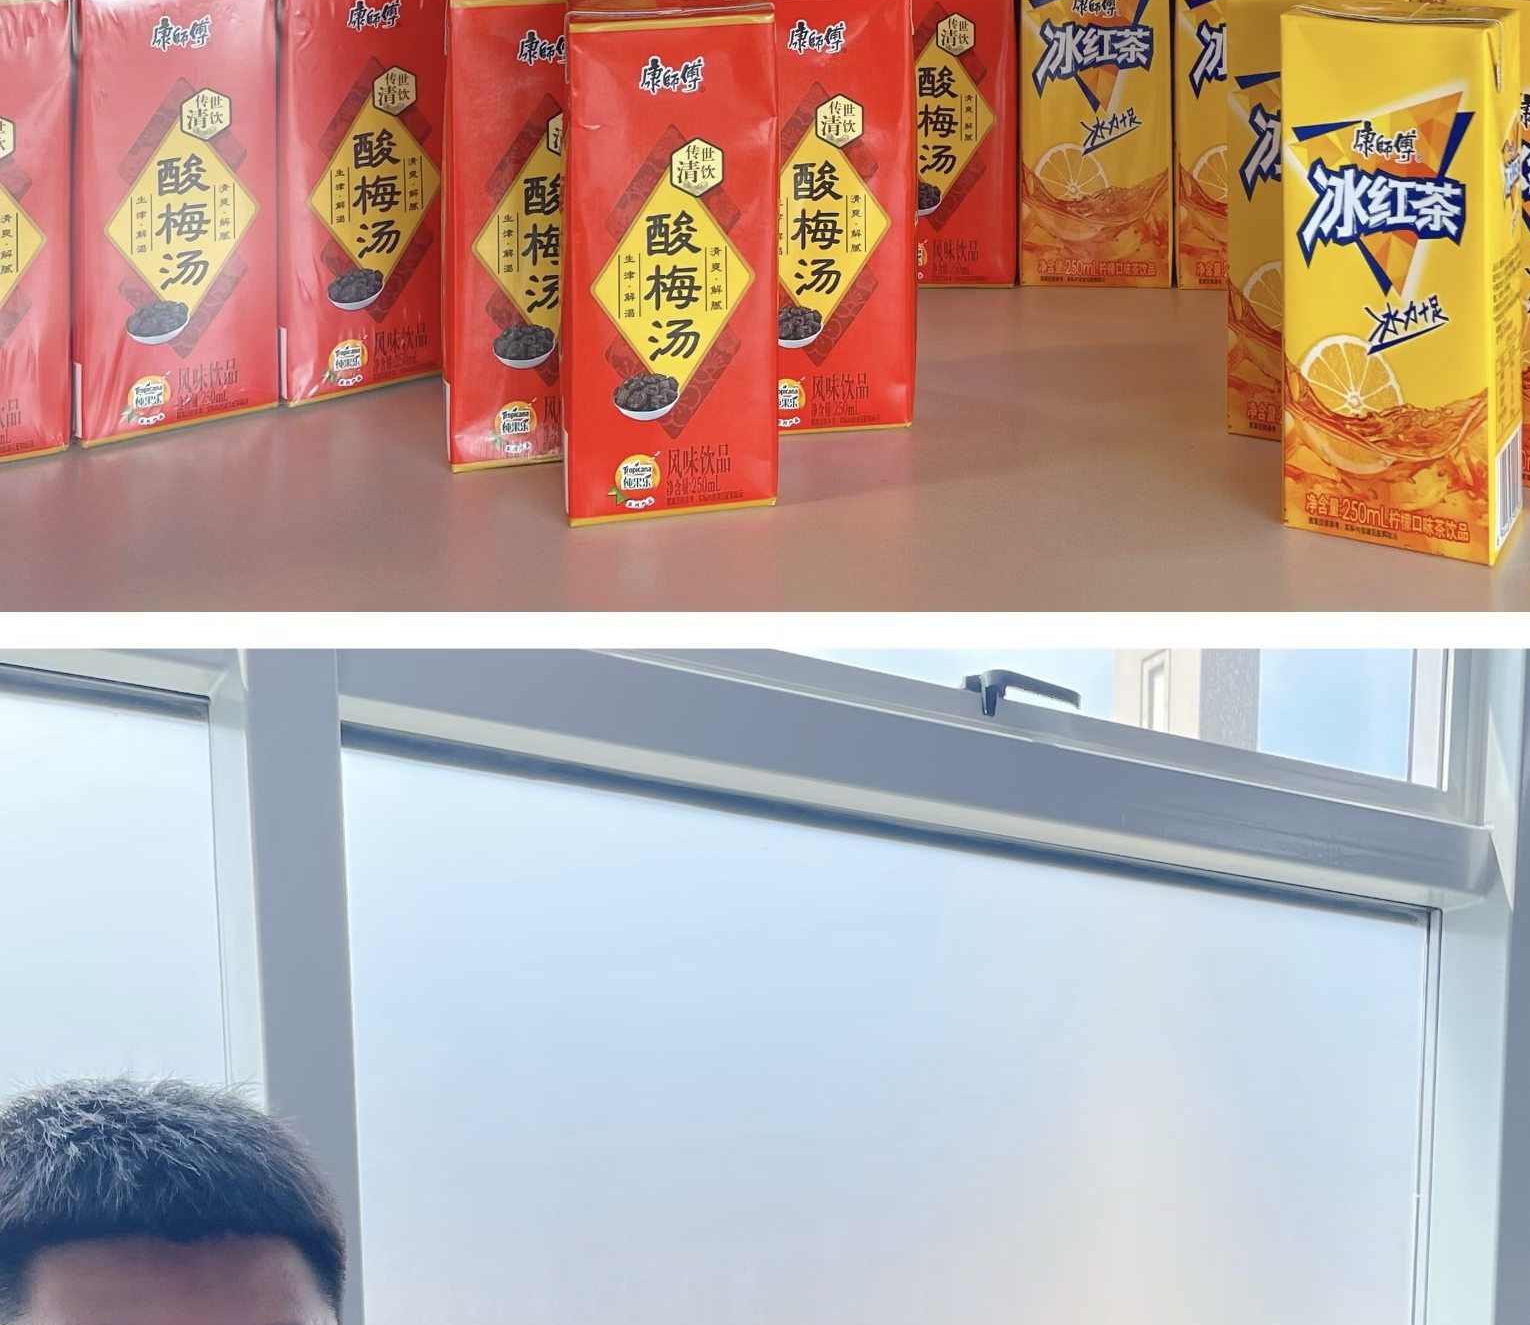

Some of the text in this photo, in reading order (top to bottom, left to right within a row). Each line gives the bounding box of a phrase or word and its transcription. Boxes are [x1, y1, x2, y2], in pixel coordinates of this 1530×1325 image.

[1035, 23, 1150, 87] 冰红茶
[916, 65, 959, 175] 酸梅汤
[1080, 107, 1142, 146] 冰力十足
[352, 127, 402, 259] 酸梅汤
[1302, 163, 1462, 252] 冰红茶
[154, 152, 212, 291] 酸梅汤
[790, 159, 844, 296] 酸梅汤
[932, 238, 979, 262] 风味饮品
[643, 209, 703, 362] 酸梅汤
[1364, 294, 1450, 343] 冰力十足
[177, 358, 239, 394] 风味饮品
[811, 373, 869, 400] 风味饮品
[623, 464, 652, 475] Tropicana
[667, 443, 731, 477] 风味饮品
